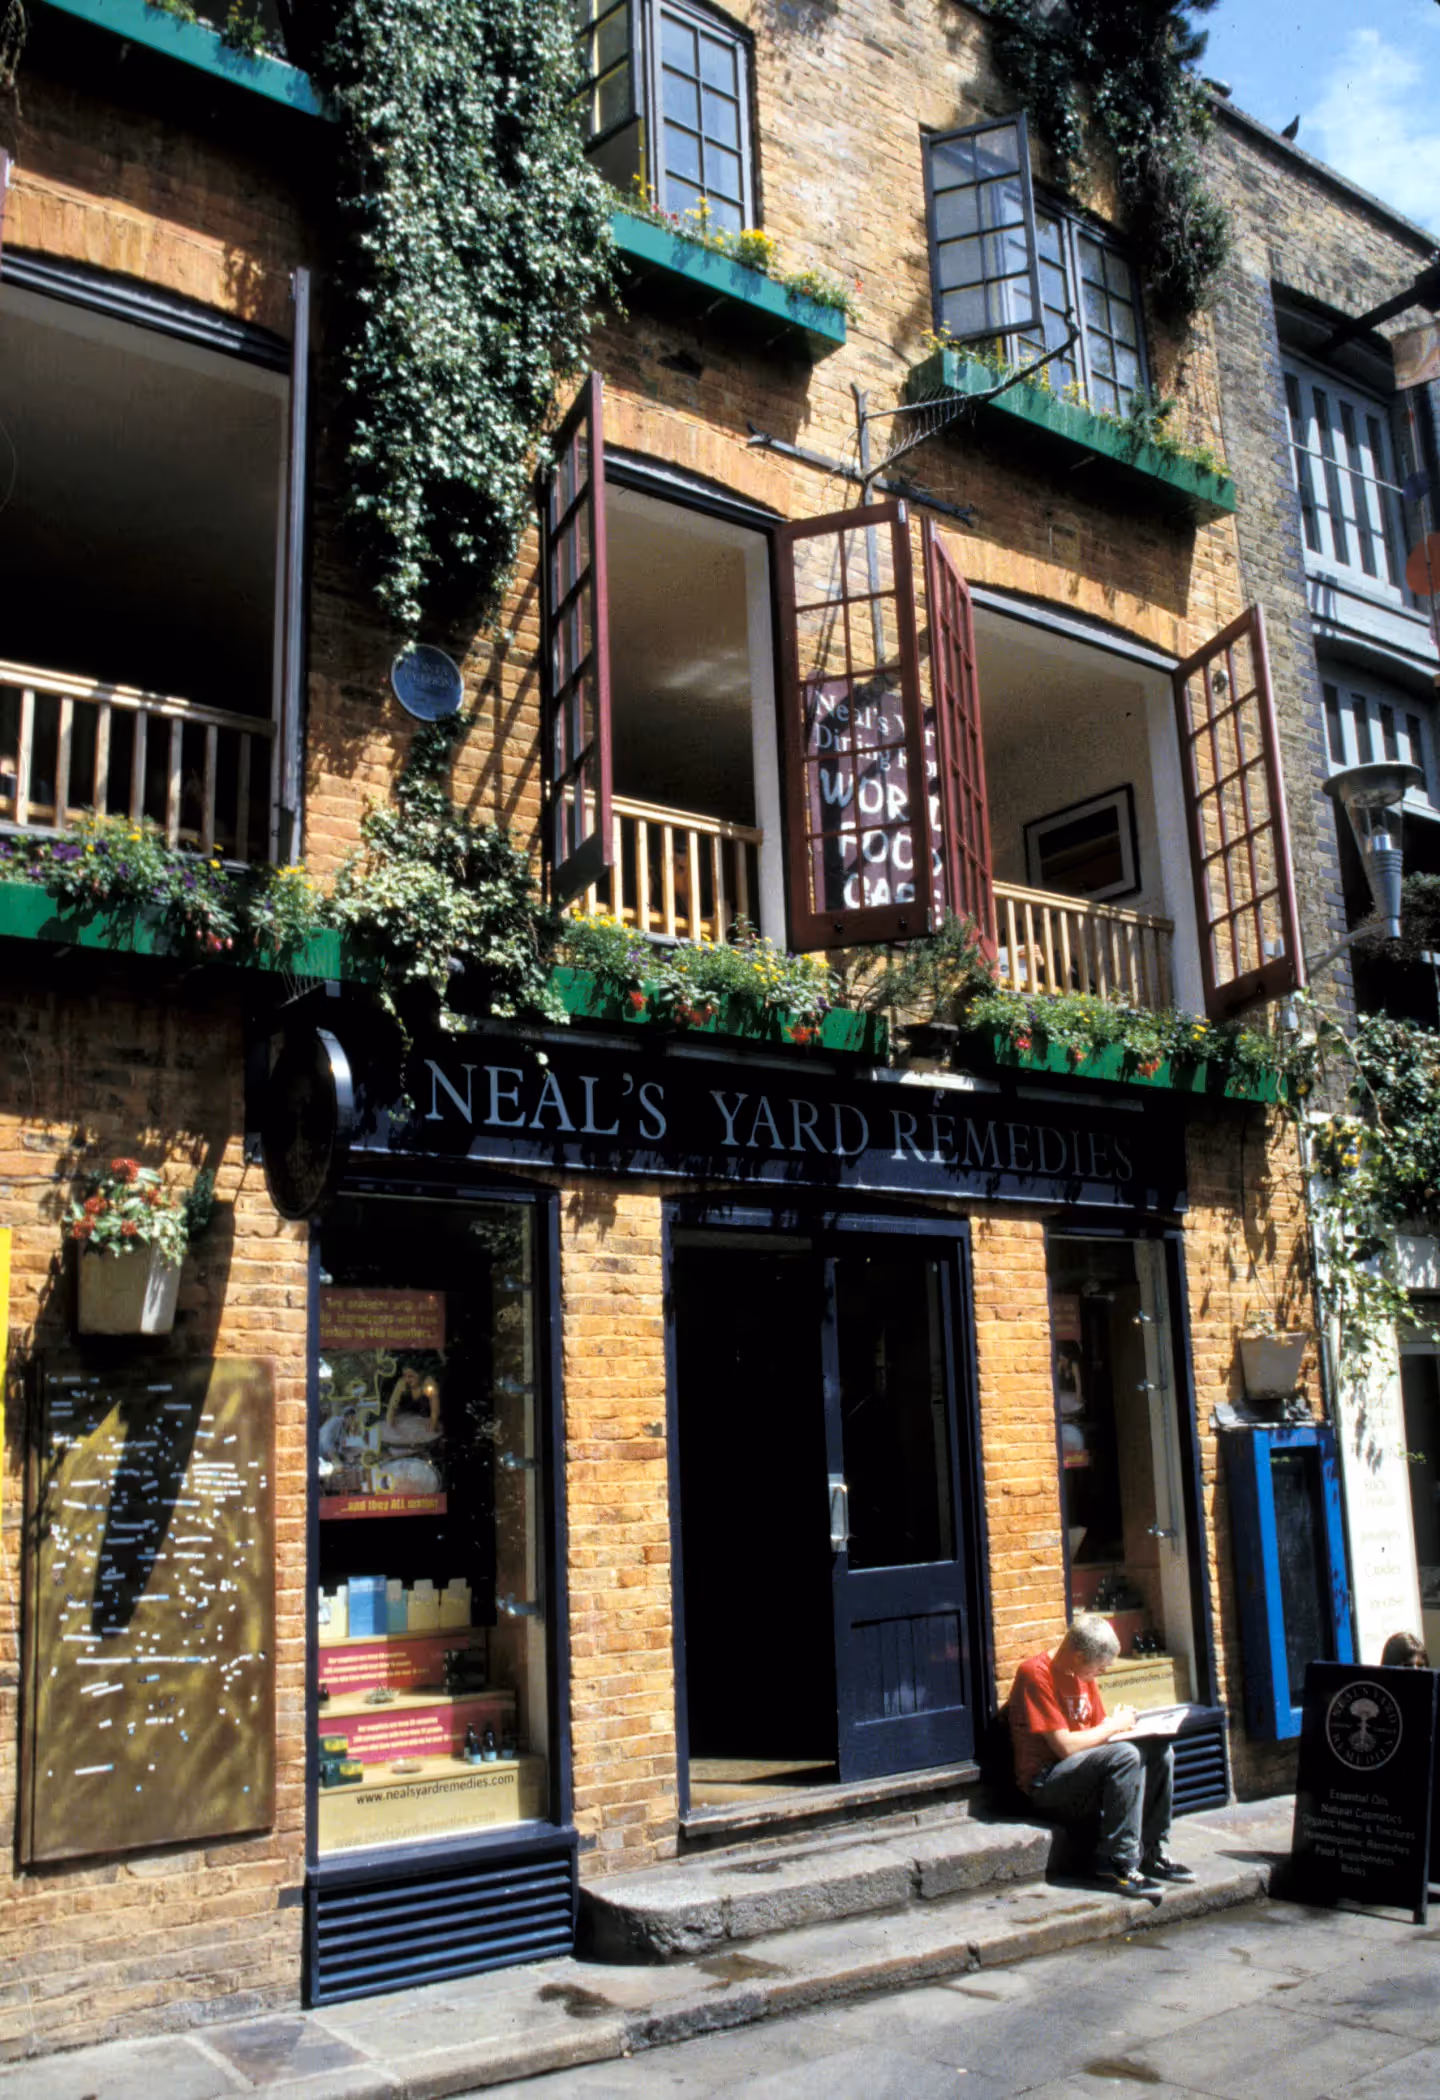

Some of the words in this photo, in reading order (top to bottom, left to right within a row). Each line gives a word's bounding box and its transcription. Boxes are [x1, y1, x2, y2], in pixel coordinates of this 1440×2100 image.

[424, 1058, 668, 1140] NEAL'S
[710, 1089, 870, 1156] YARD
[889, 1109, 1135, 1183] REMEDIES
[356, 1773, 514, 1805] www.nealsyardremedies.com
[1329, 1788, 1369, 1804] Essential
[1320, 1802, 1353, 1817] Natural
[1355, 1807, 1403, 1826] Cosmetics
